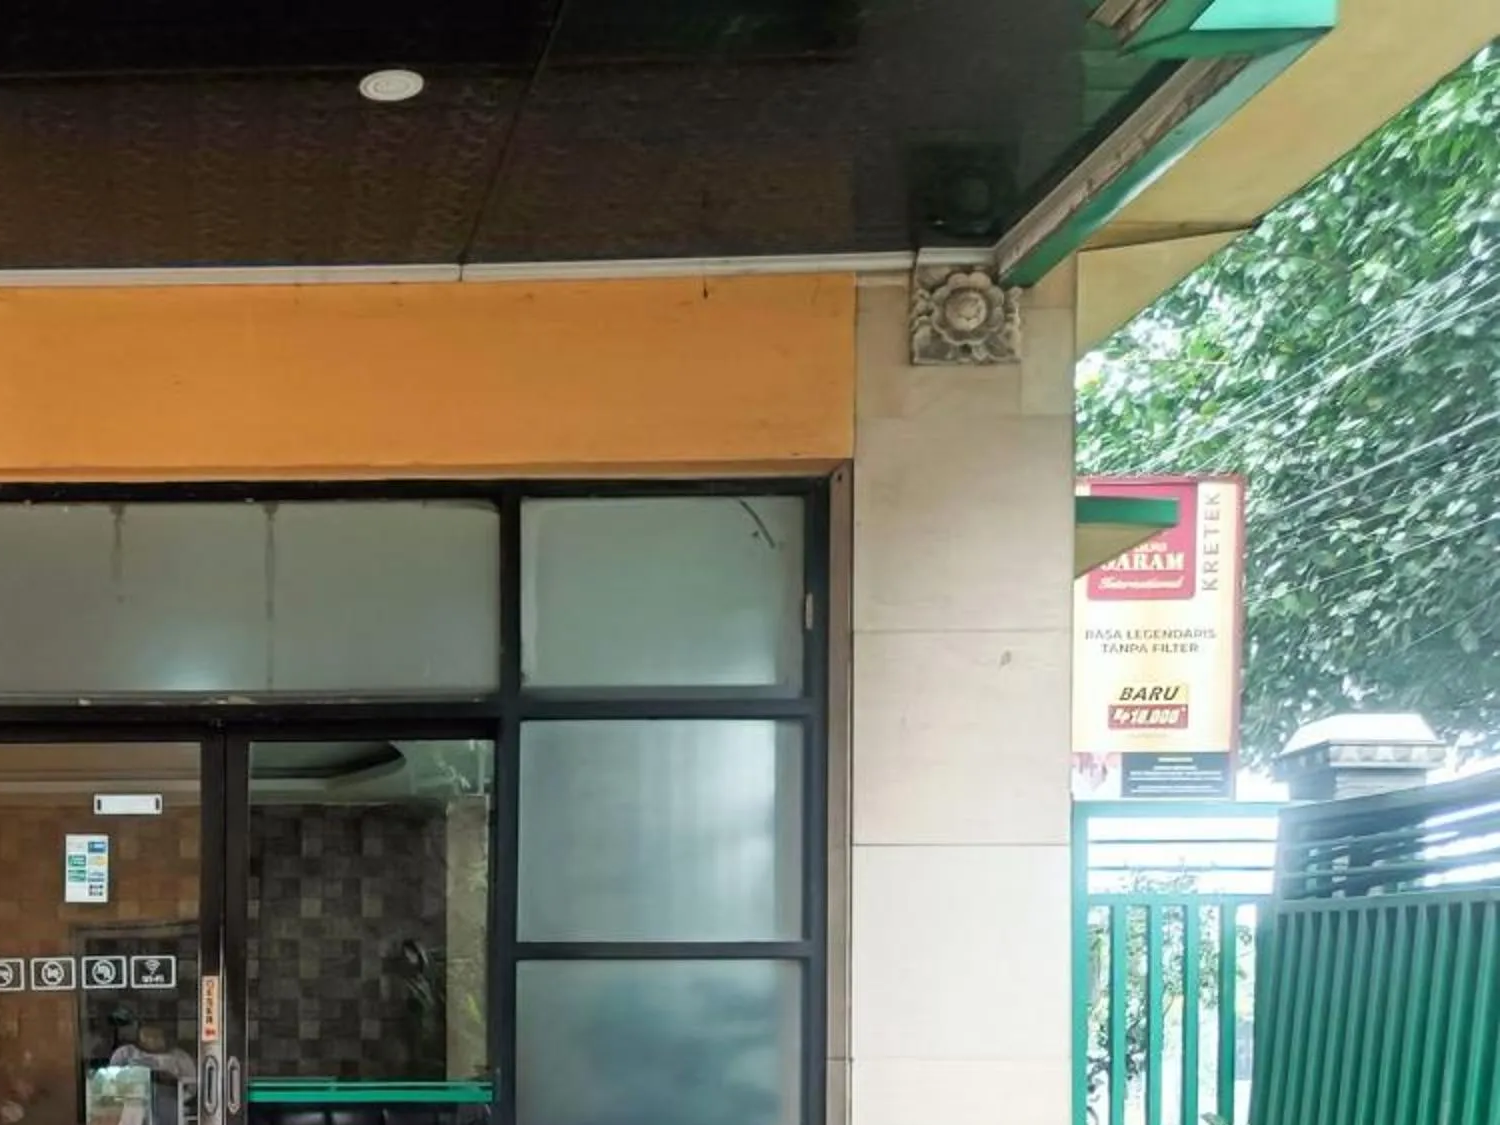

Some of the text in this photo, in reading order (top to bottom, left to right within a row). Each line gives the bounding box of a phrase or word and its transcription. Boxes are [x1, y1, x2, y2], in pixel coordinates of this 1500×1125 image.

[1201, 492, 1220, 591] KRETEK
[1085, 628, 1217, 641] RASA LEGENDARIS
[1101, 643, 1199, 654] TANPA FILTER
[1119, 686, 1180, 701] BARU
